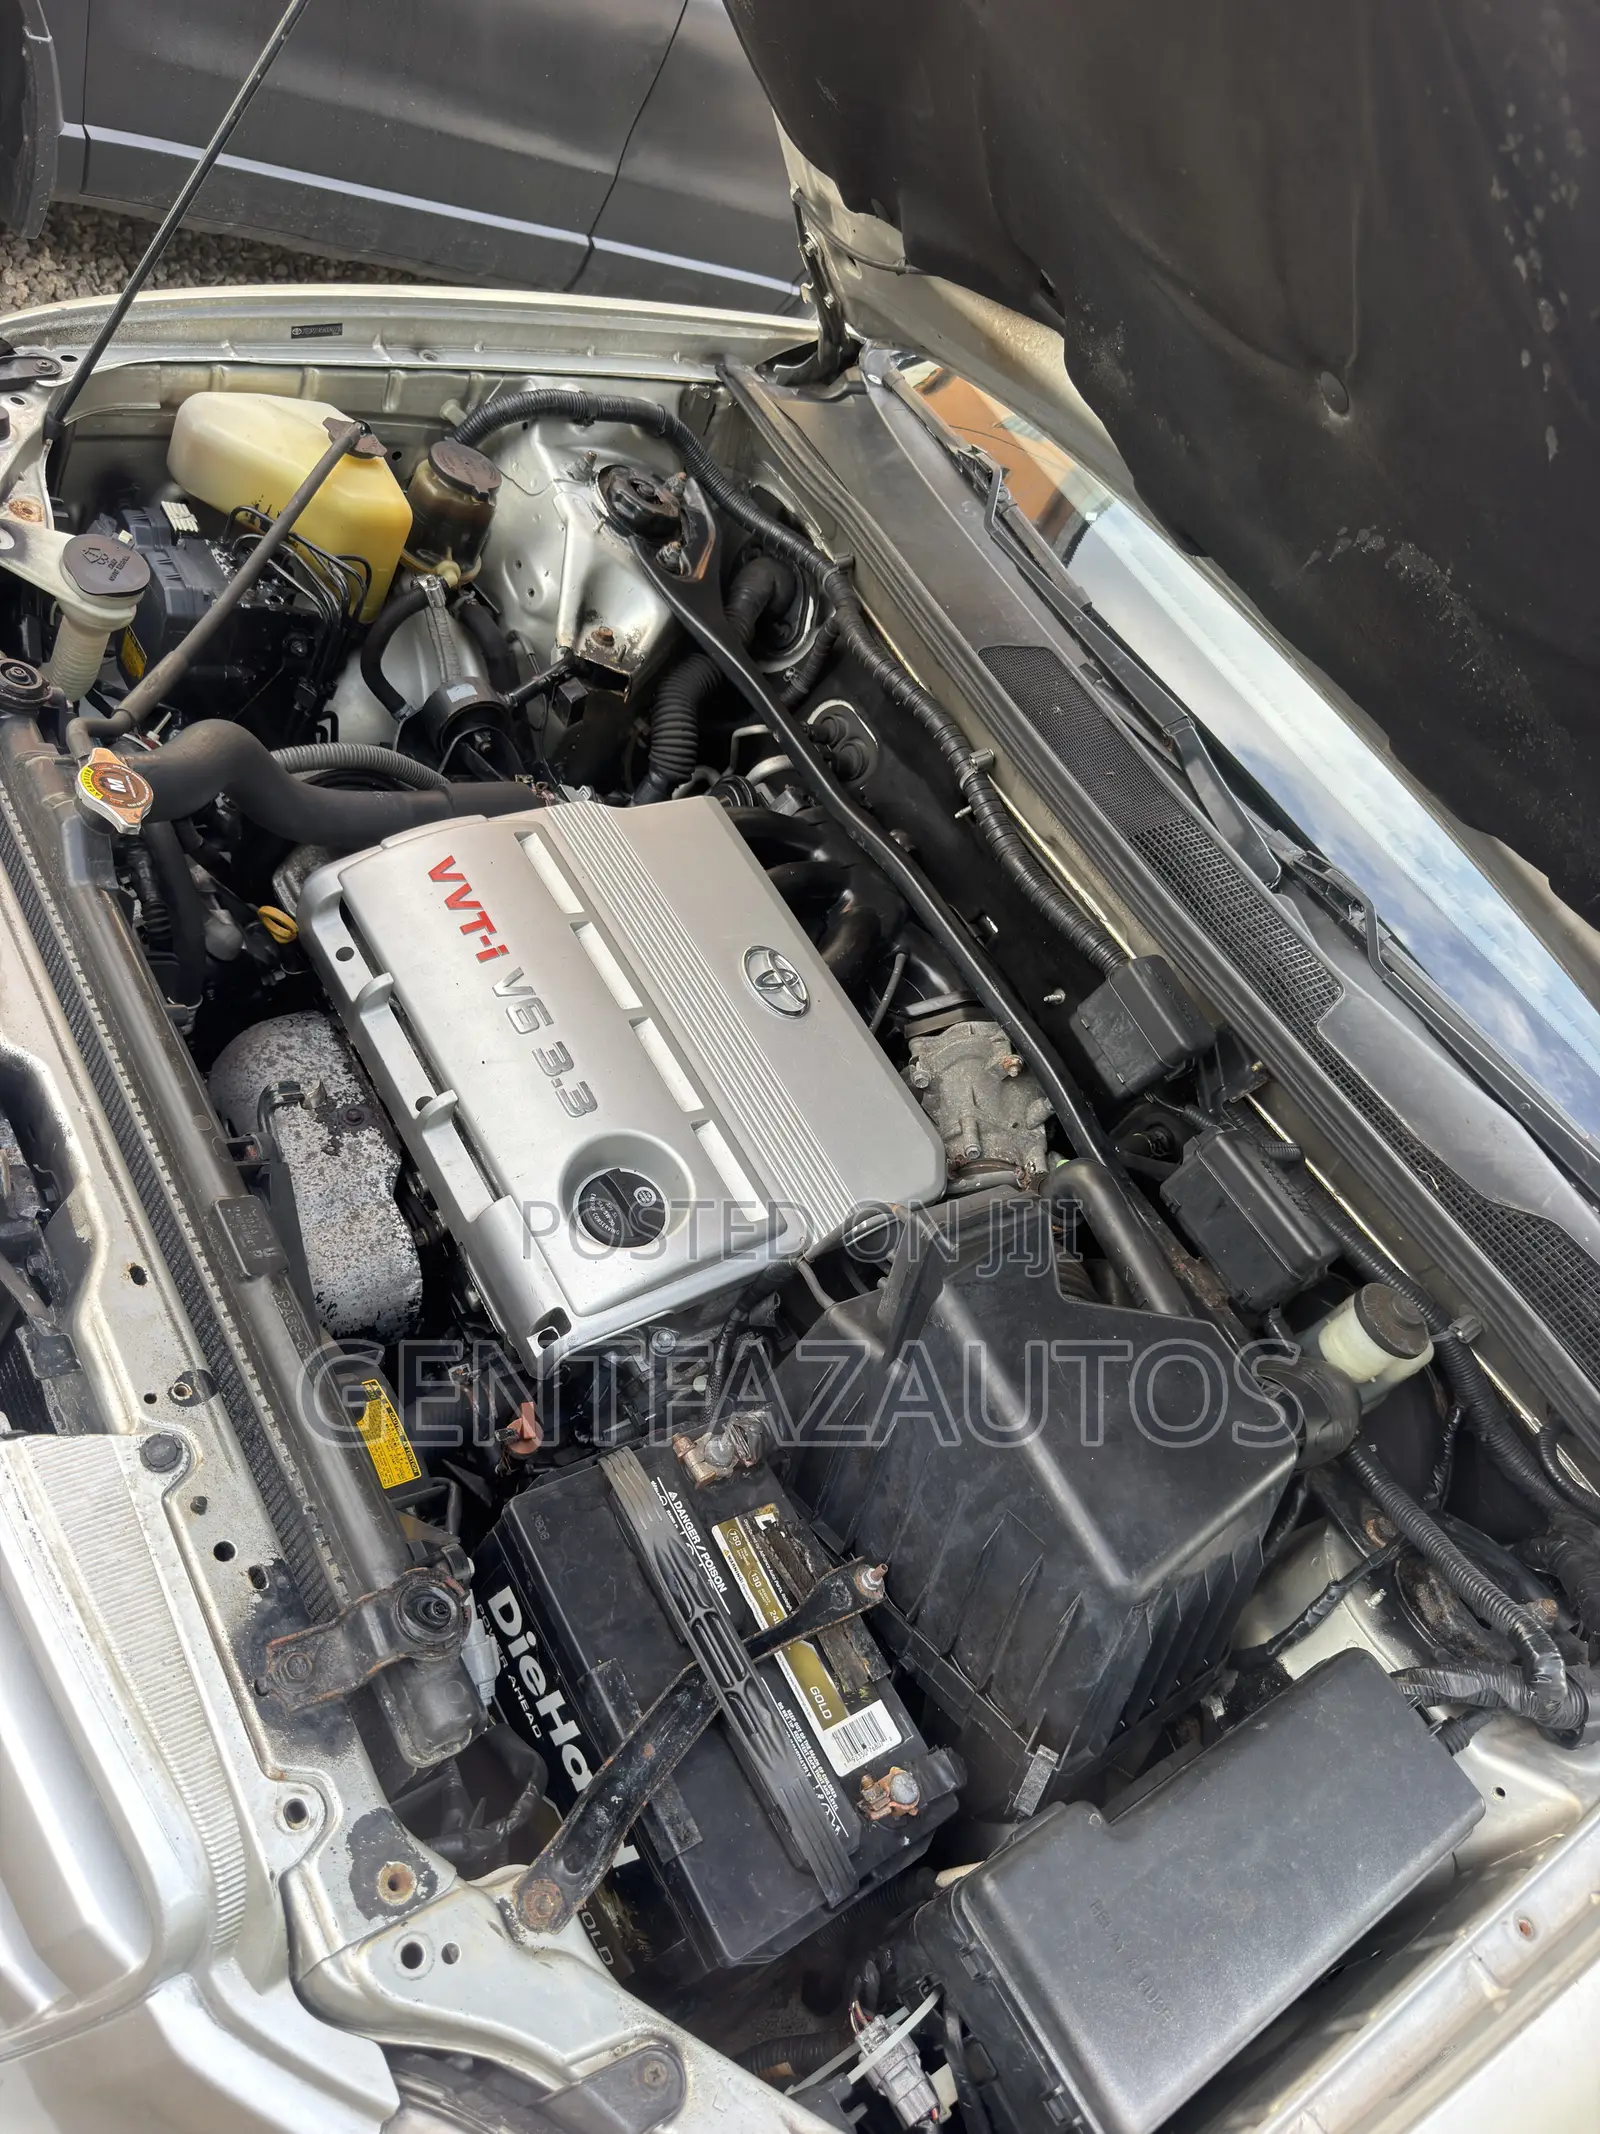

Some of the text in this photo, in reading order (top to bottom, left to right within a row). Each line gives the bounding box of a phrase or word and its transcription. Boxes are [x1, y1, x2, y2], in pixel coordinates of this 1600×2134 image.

[427, 854, 599, 1118] VVT-i V6 3.3
[672, 1500, 702, 1541] DANGER
[700, 1553, 728, 1593] POISON
[728, 1530, 741, 1547] 750
[750, 1572, 762, 1587] 130
[488, 1584, 641, 1869] DieHa
[507, 1673, 543, 1740] AHEAD
[809, 1686, 833, 1720] GOLD
[580, 1901, 614, 1966] OLD
